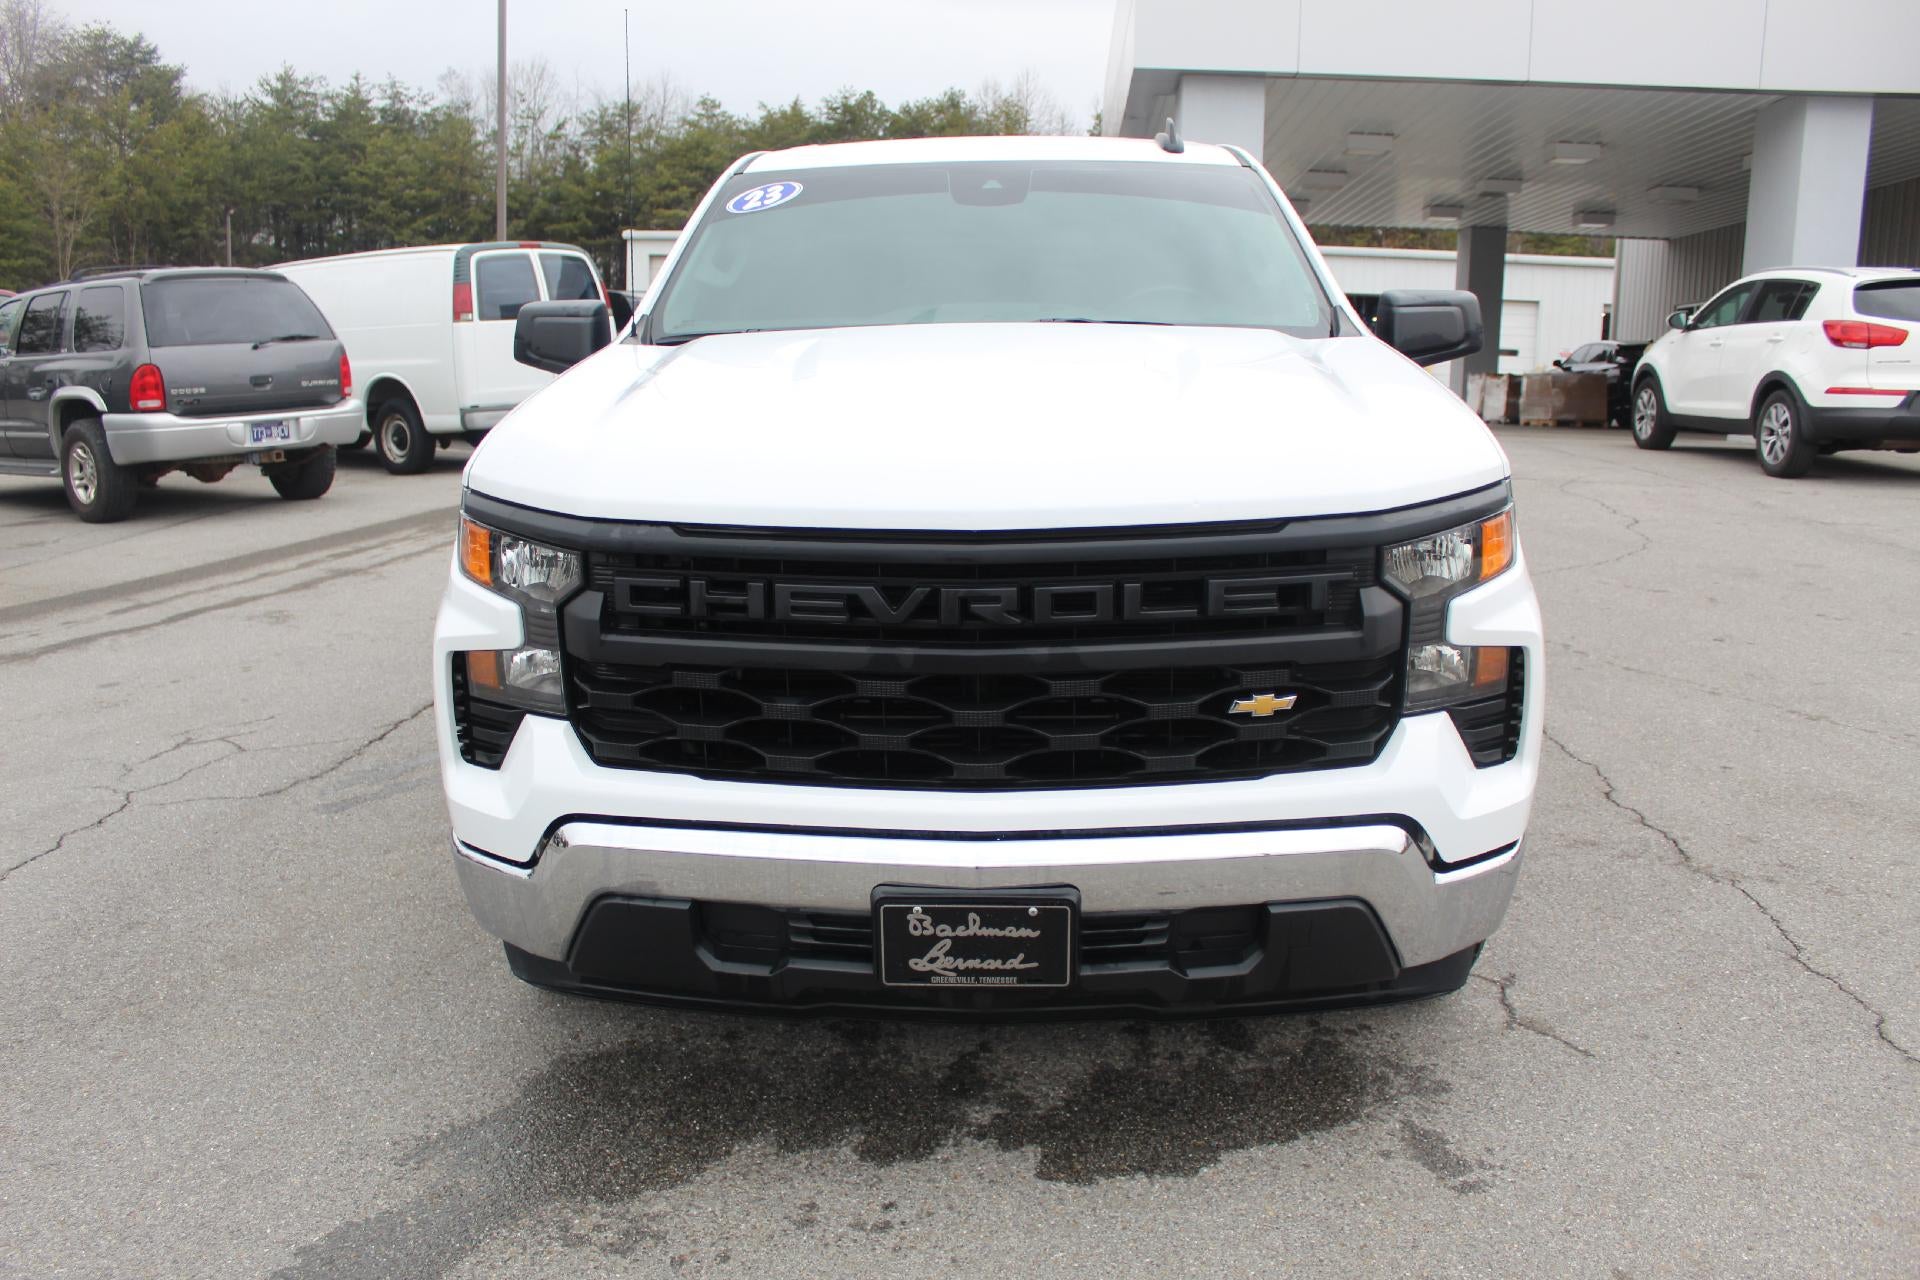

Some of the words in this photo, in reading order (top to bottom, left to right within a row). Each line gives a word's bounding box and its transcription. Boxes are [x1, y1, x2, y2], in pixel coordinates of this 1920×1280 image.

[742, 185, 785, 211] 23
[614, 572, 1354, 624] CHEVROLET
[907, 912, 1041, 938] Bachman
[908, 938, 1040, 976] Bernard
[979, 976, 1017, 984] TENNESSEE
